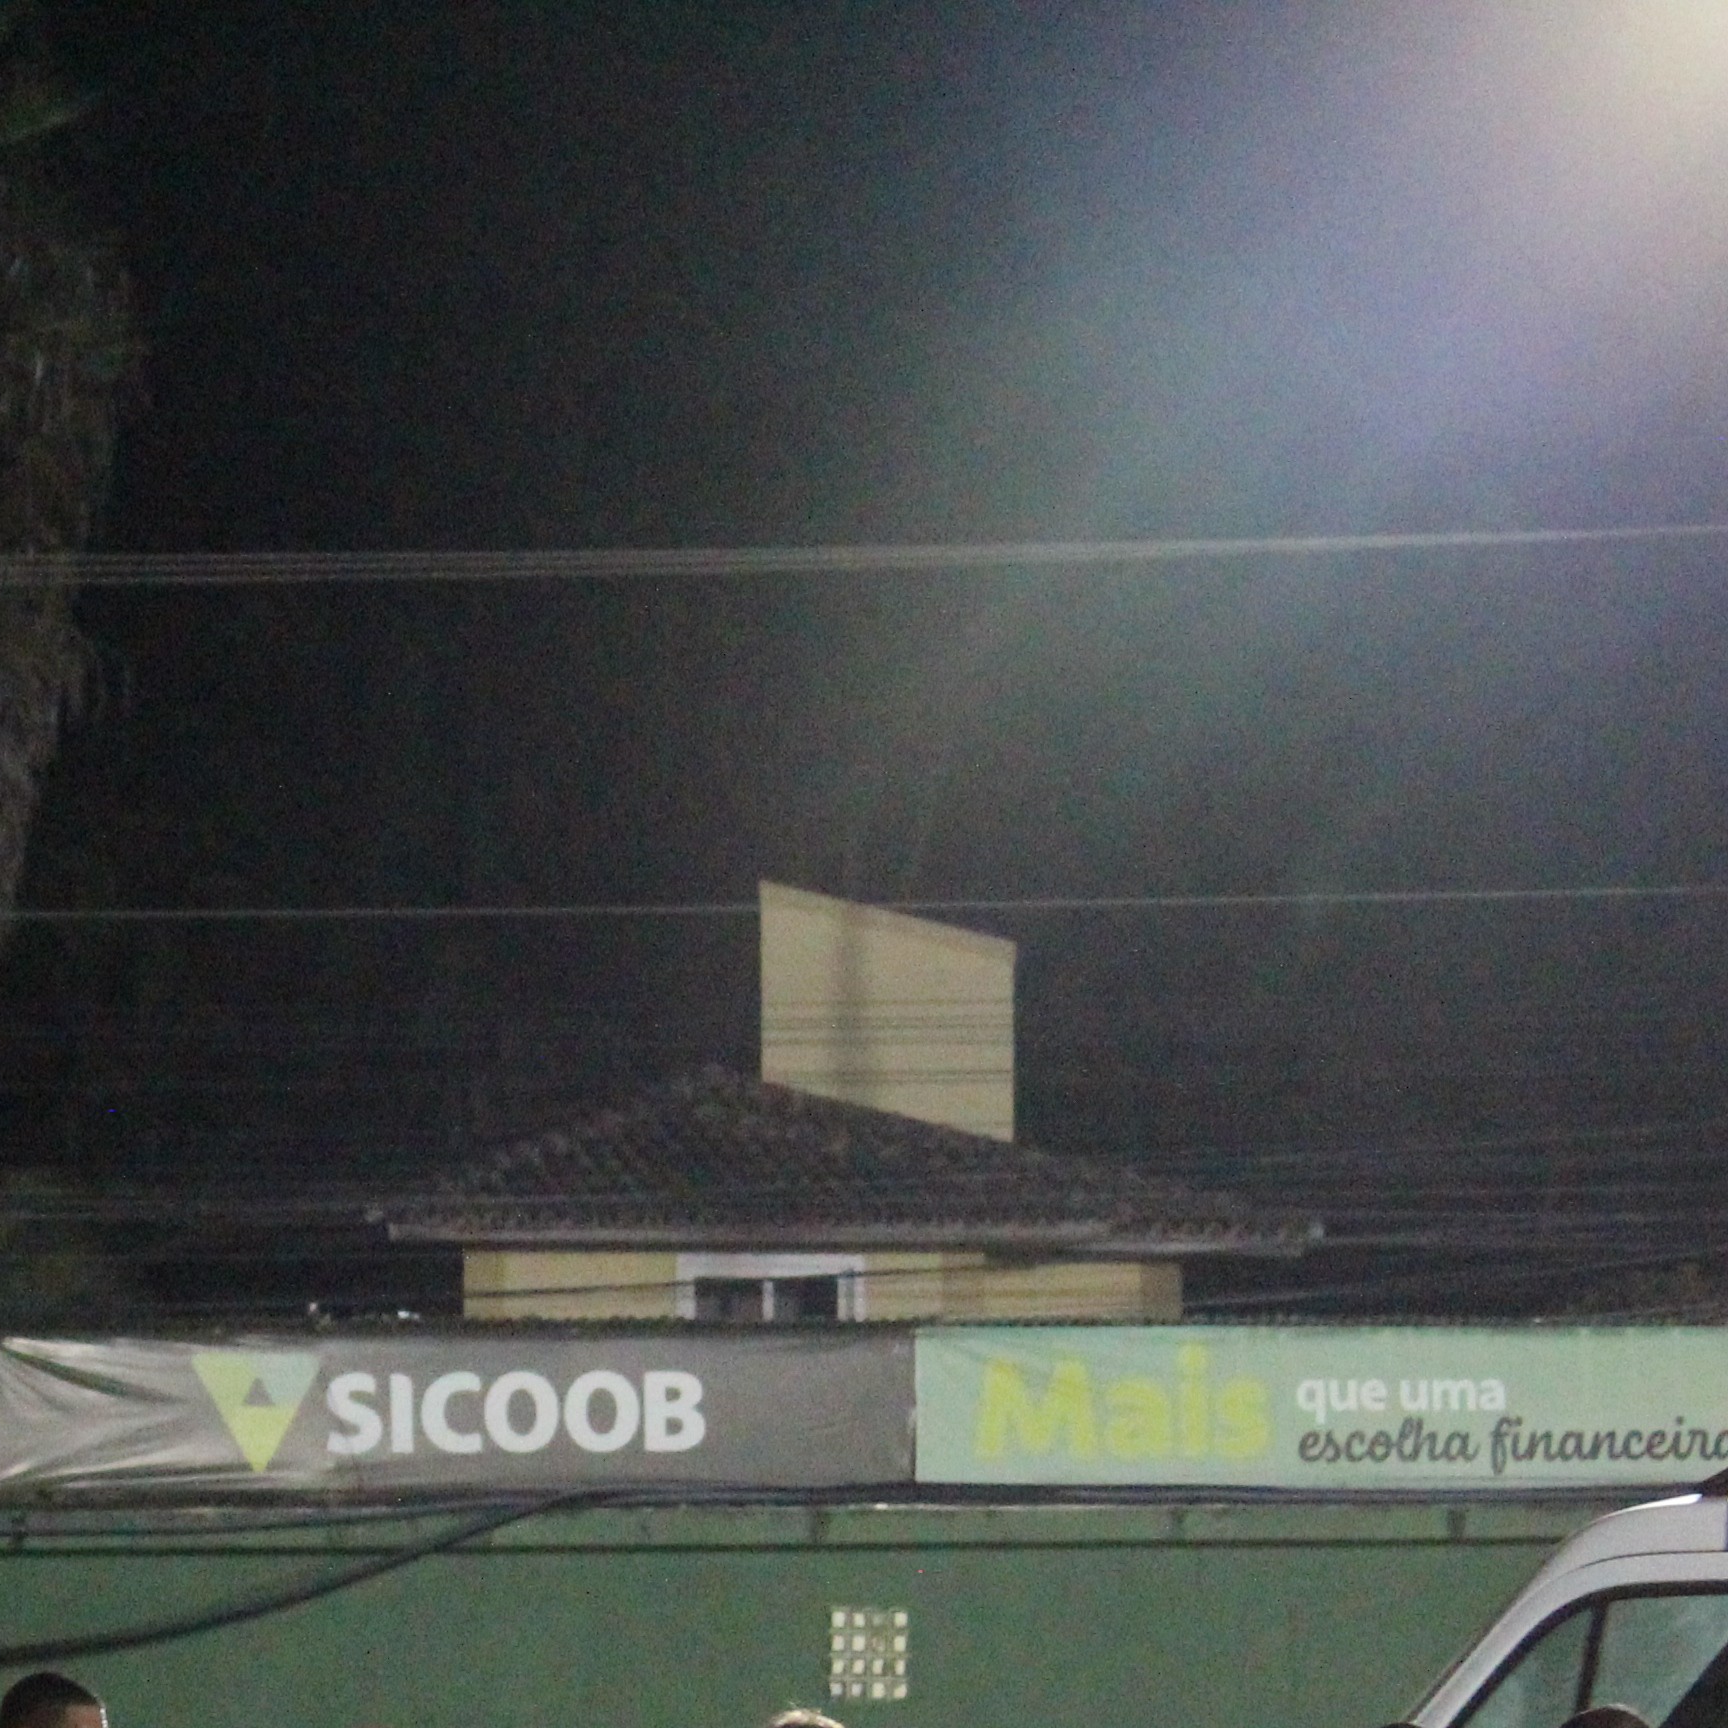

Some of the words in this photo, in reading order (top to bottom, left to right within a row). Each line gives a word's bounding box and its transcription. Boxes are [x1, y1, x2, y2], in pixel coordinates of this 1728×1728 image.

[326, 1370, 706, 1454] SICOOB
[973, 1343, 1270, 1459] Mais
[1297, 1378, 1388, 1424] que
[1399, 1378, 1507, 1412] uma
[1298, 1416, 1478, 1463] escolha
